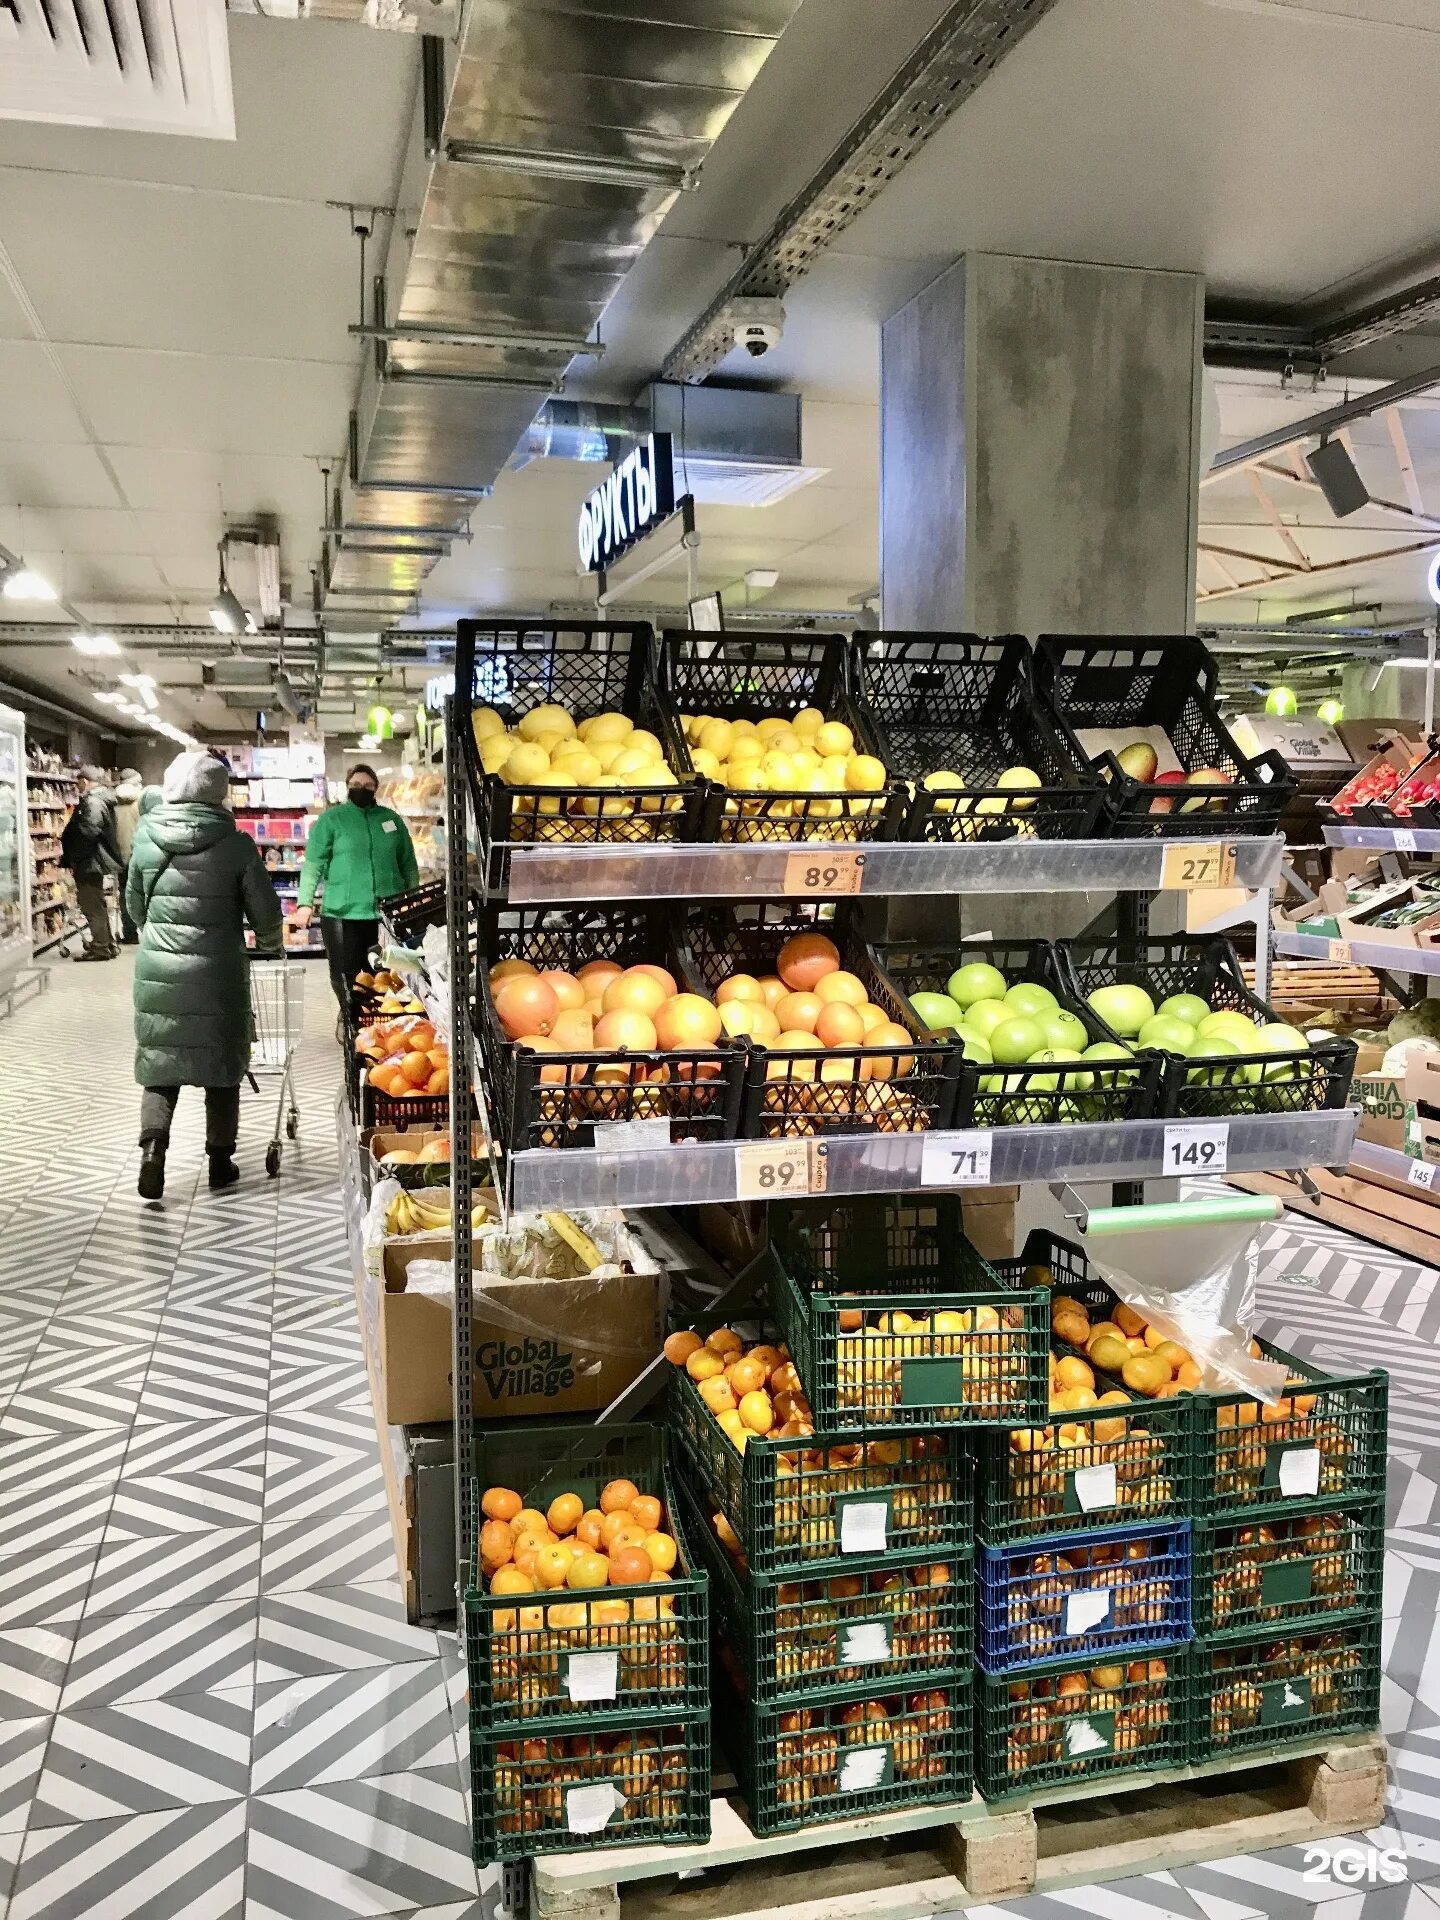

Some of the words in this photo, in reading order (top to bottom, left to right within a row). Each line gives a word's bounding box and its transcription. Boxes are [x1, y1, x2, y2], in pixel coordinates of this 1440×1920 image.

[578, 432, 657, 571] ФРУКТЫ
[804, 867, 838, 887] 89
[1181, 859, 1211, 881] 27
[951, 1150, 977, 1174] 71
[1171, 1141, 1216, 1165] 149
[759, 1162, 795, 1188] 89
[815, 1160, 823, 1189] Скидка
[1413, 1169, 1429, 1183] 145
[476, 1336, 558, 1371] Global
[483, 1366, 576, 1401] Village
